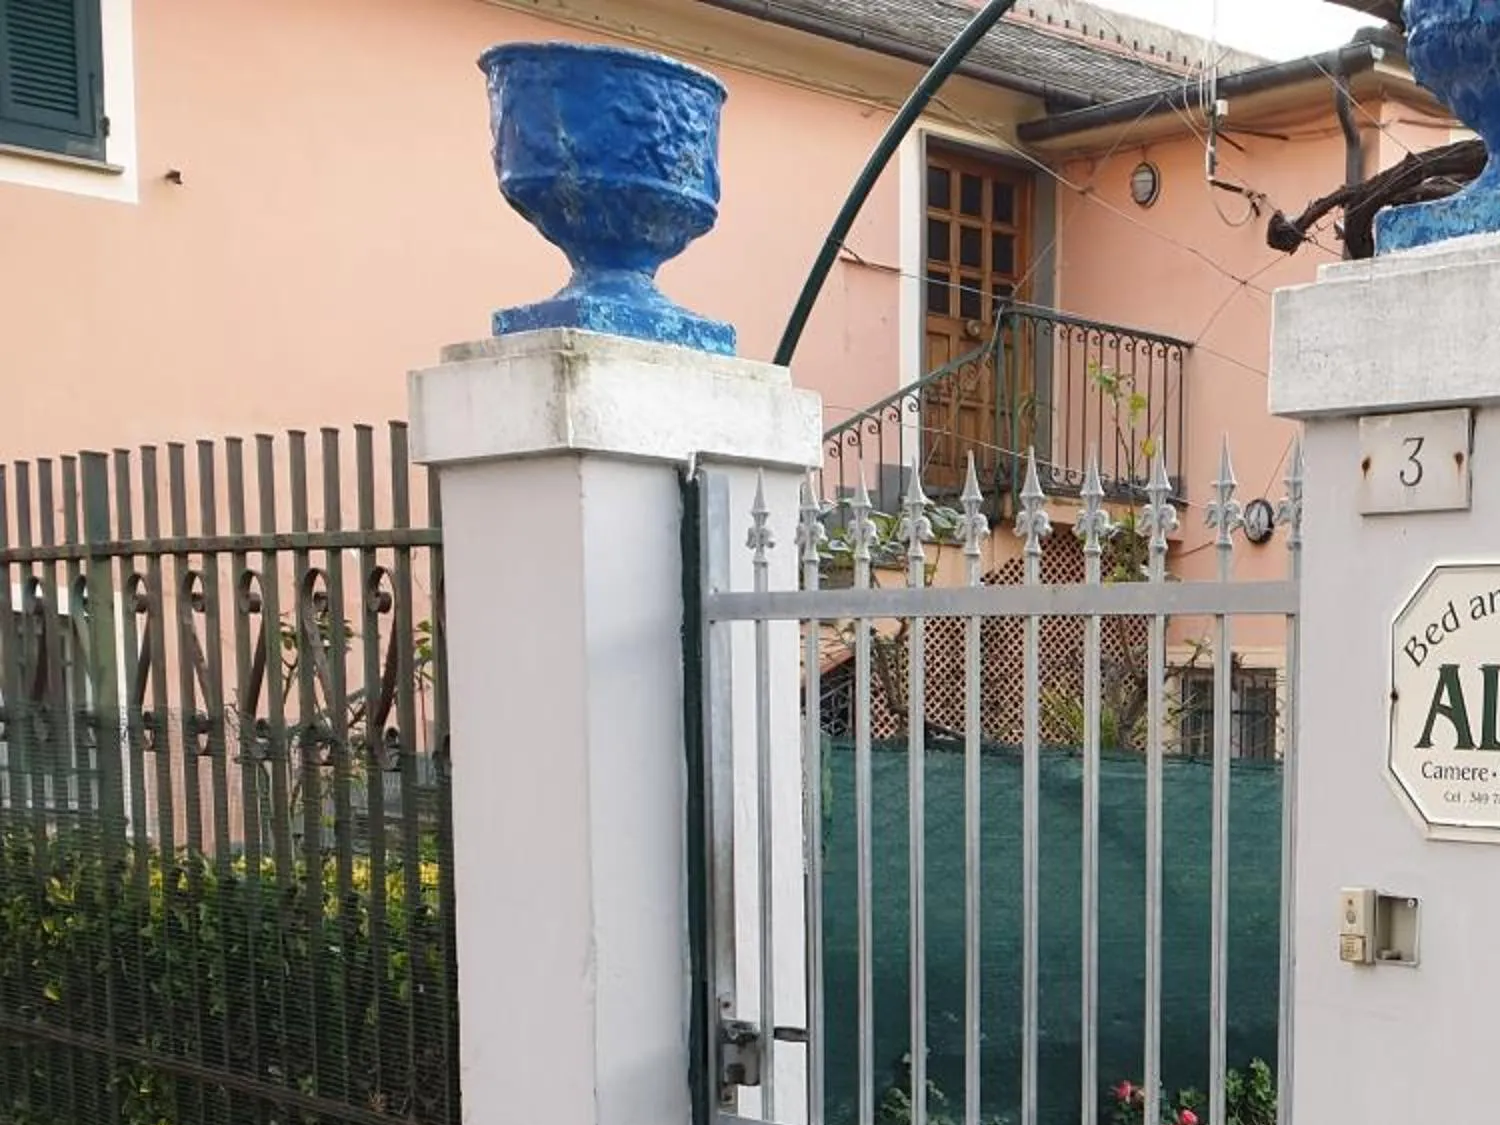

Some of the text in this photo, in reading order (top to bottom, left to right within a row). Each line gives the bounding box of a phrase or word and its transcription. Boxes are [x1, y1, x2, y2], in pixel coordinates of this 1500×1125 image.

[1400, 436, 1424, 487] 3
[1403, 601, 1460, 667] Bed
[1421, 760, 1489, 782] Camere
